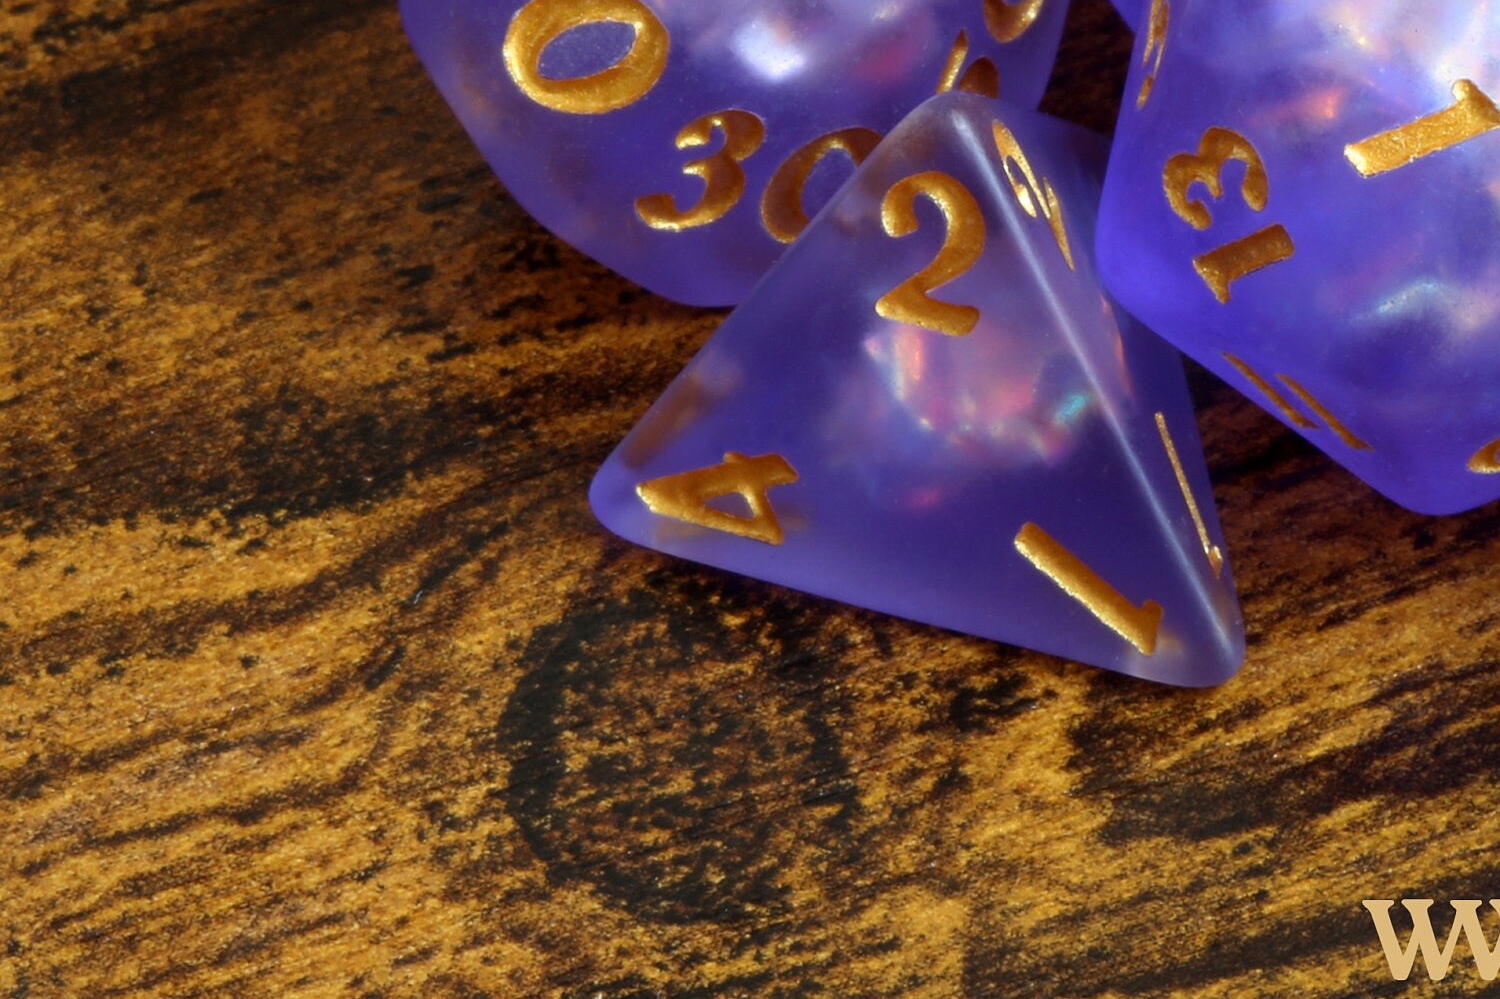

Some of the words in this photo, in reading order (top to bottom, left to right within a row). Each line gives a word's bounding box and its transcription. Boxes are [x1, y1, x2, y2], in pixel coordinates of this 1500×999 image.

[875, 170, 987, 338] 2
[1162, 125, 1295, 304] 13
[635, 450, 799, 546] 4
[1013, 520, 1164, 657] 1
